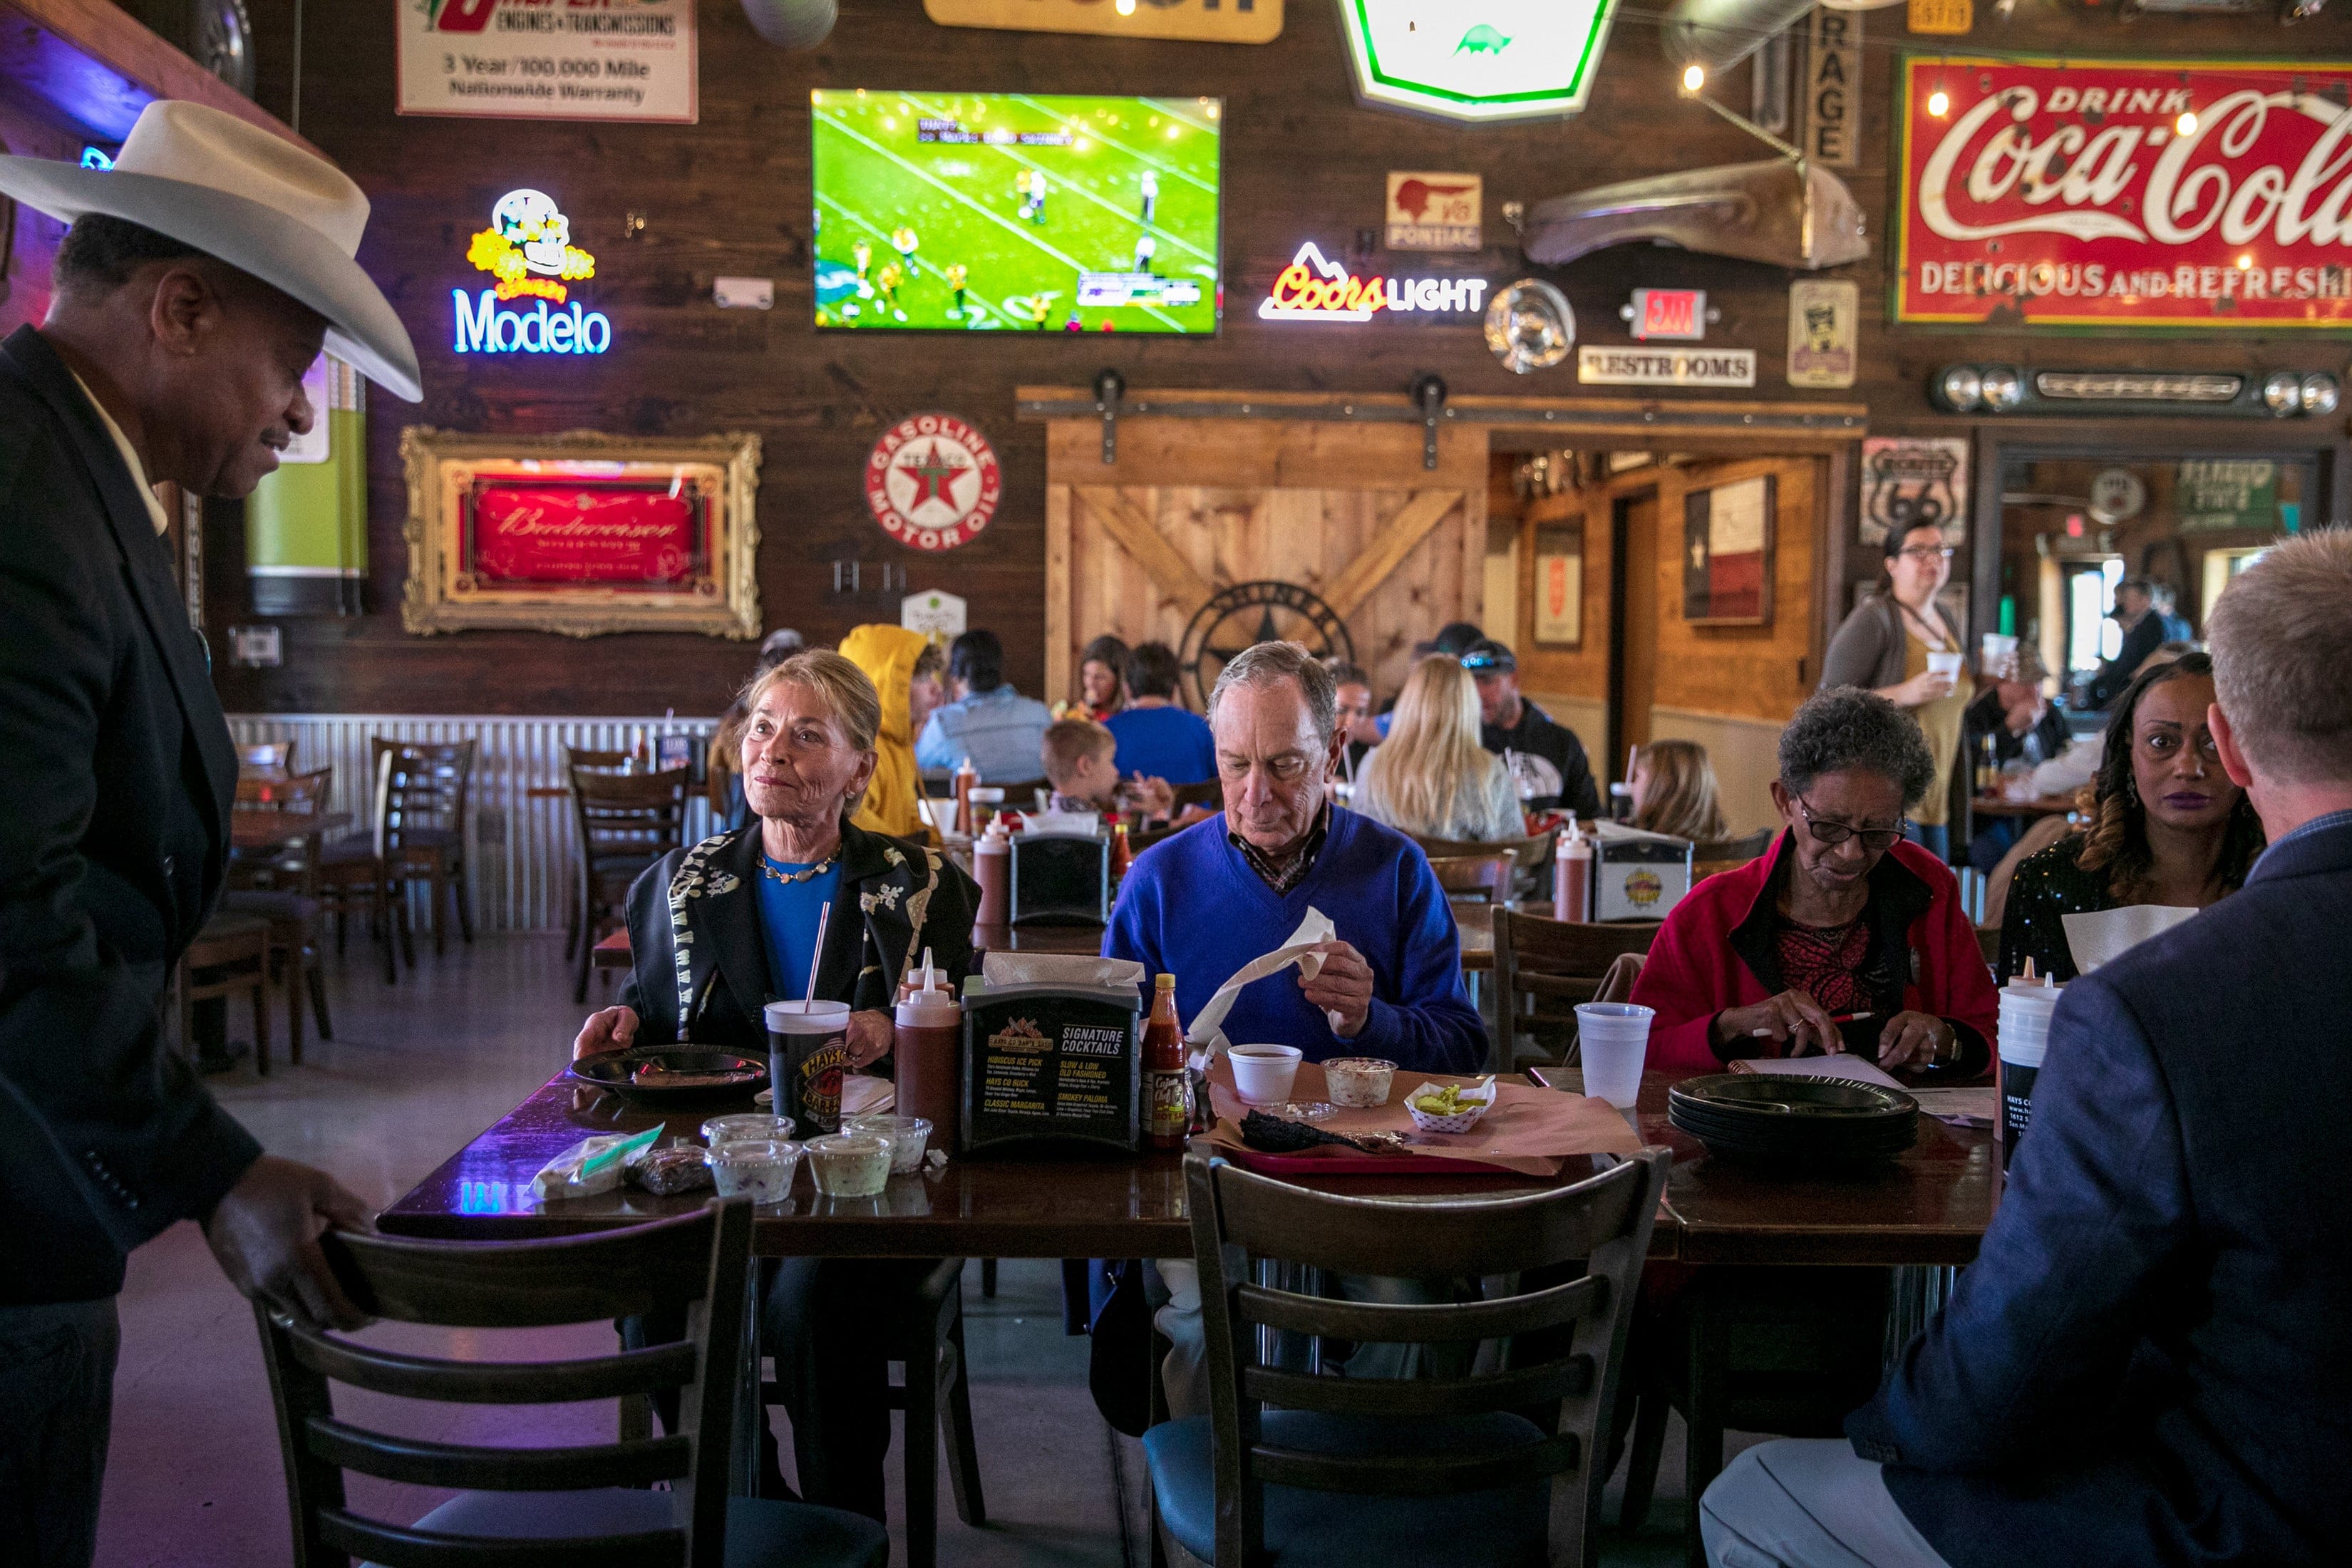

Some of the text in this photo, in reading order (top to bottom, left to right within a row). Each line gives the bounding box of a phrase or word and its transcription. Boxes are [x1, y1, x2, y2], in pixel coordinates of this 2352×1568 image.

[2043, 86, 2193, 116] DRINK
[1389, 227, 1482, 247] PONTIAC
[1273, 264, 1487, 312] Coors LIGHT
[1920, 261, 2106, 297] DELICIOUS
[2108, 271, 2170, 299] AND
[452, 288, 612, 355] Modelo
[1645, 290, 1697, 335] EXIT
[871, 415, 997, 472] GASOLINE
[497, 507, 679, 539] Budweiser
[868, 487, 999, 550] MOTOR OIL
[1063, 1027, 1124, 1043] SIGNATURE
[1062, 1039, 1120, 1055] COCKTAILS
[808, 1049, 838, 1074] HAYS
[987, 1056, 1016, 1065] HIBISCUS
[1028, 1058, 1043, 1067] PICK
[986, 1077, 1002, 1085] HAYS
[1012, 1079, 1029, 1088] BUCK
[1072, 1071, 1107, 1079] FASHIONED
[1155, 1076, 1179, 1091] Cajun
[984, 1098, 1045, 1110] CLASSIC MARGARITA
[1058, 1093, 1108, 1103] SMOKEY PALOMA
[2007, 1094, 2023, 1105] HAYS
[2010, 1113, 2023, 1122] 1612
